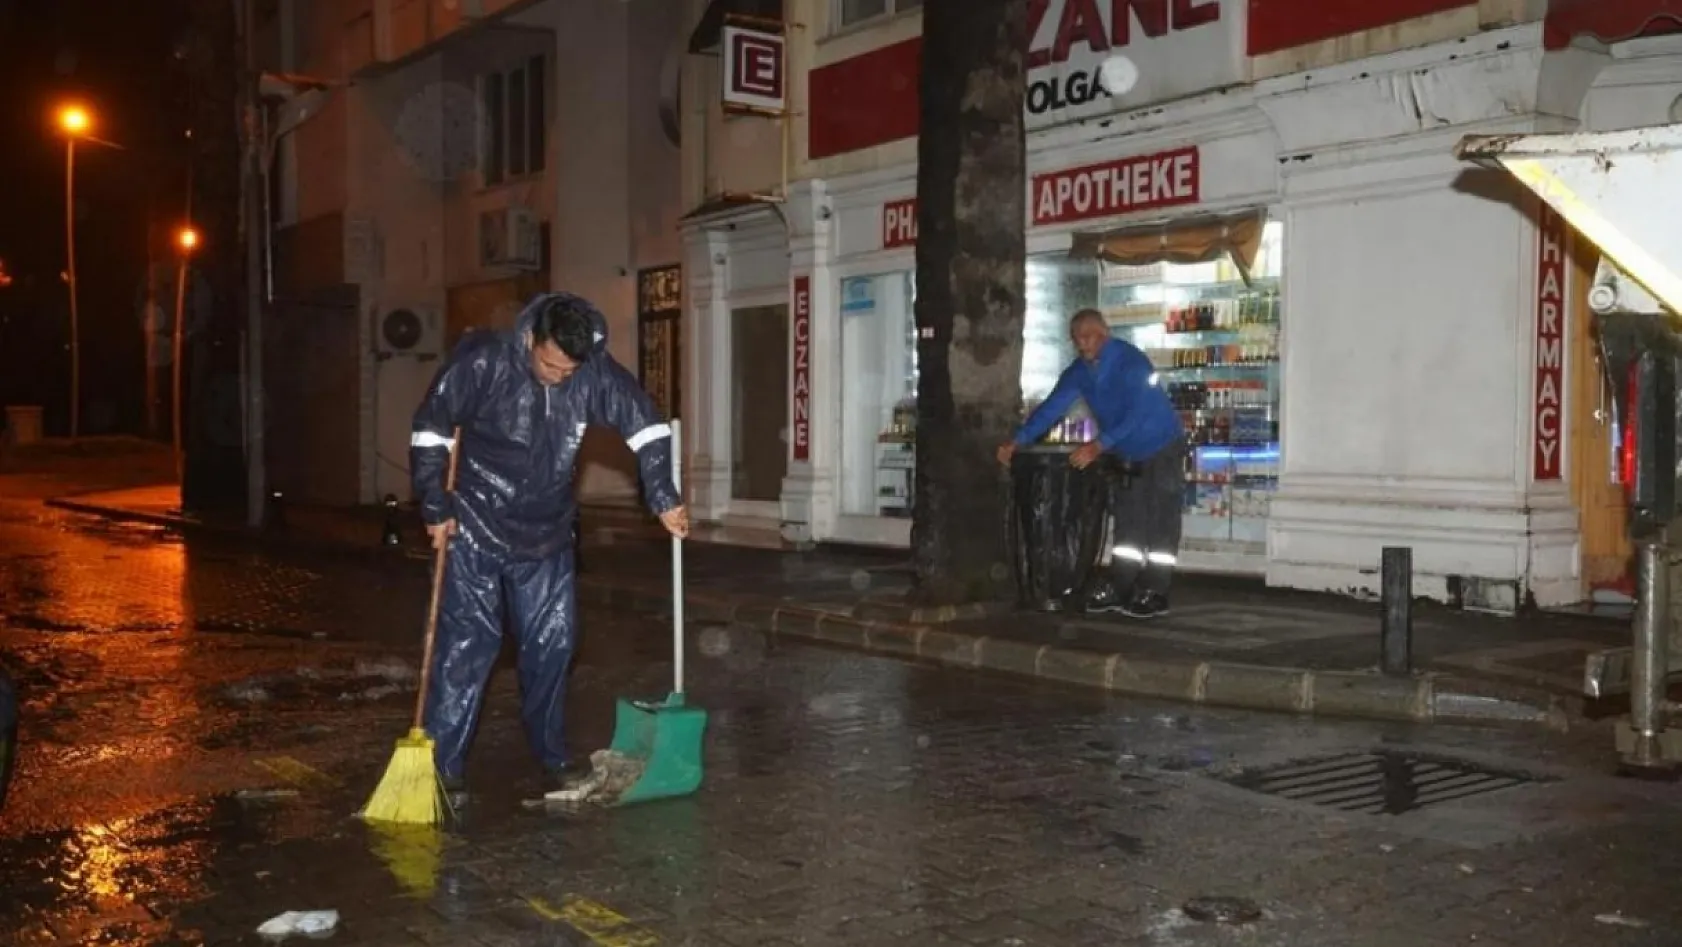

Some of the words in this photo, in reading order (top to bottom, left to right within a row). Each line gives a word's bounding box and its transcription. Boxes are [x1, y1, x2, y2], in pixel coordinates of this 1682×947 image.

[886, 204, 918, 243] PH
[1037, 153, 1193, 219] APOTHEKE
[796, 291, 808, 447] ECZANE
[1538, 205, 1561, 471] HARMACY
